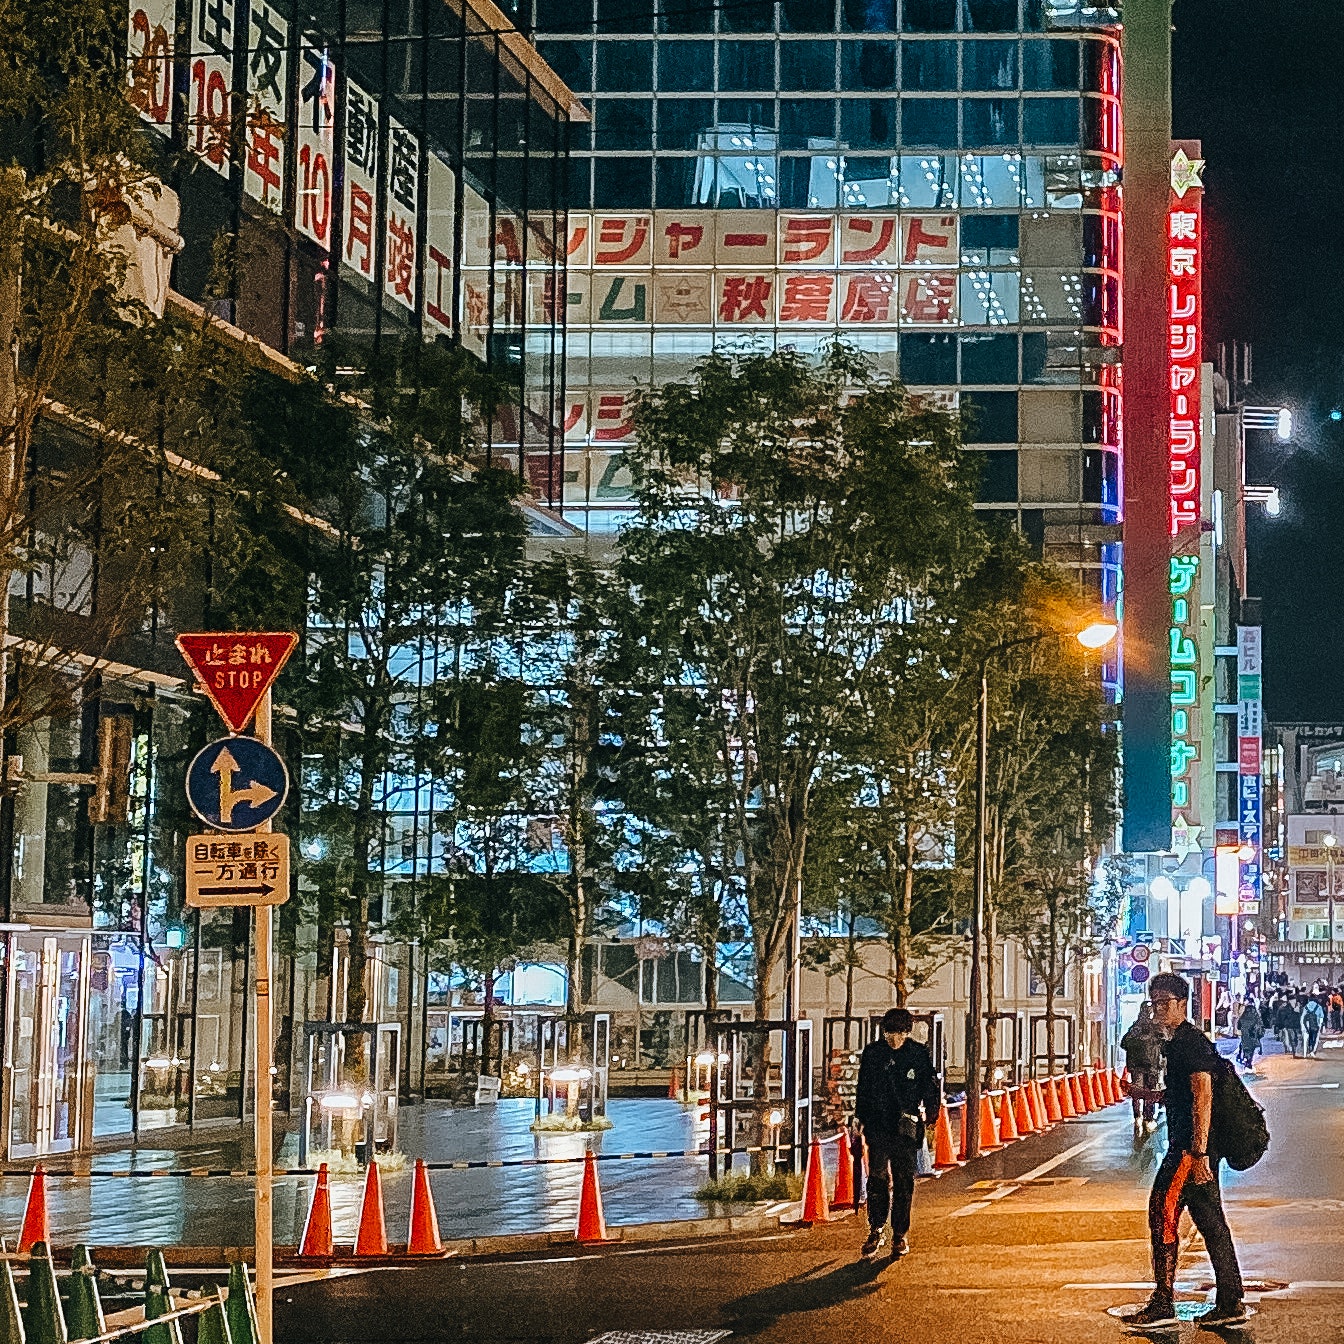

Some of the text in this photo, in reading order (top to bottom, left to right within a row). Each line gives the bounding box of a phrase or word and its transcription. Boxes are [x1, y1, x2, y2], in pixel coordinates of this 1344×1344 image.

[718, 275, 958, 323] 秋葉原店
[1170, 210, 1198, 538] 東京レジャーランド
[205, 644, 272, 665] 止まれ
[215, 671, 262, 688] STOP
[1169, 556, 1199, 806] ゲームコーナー
[194, 842, 280, 860] 自転車を除く
[194, 862, 280, 881] 一方通行
